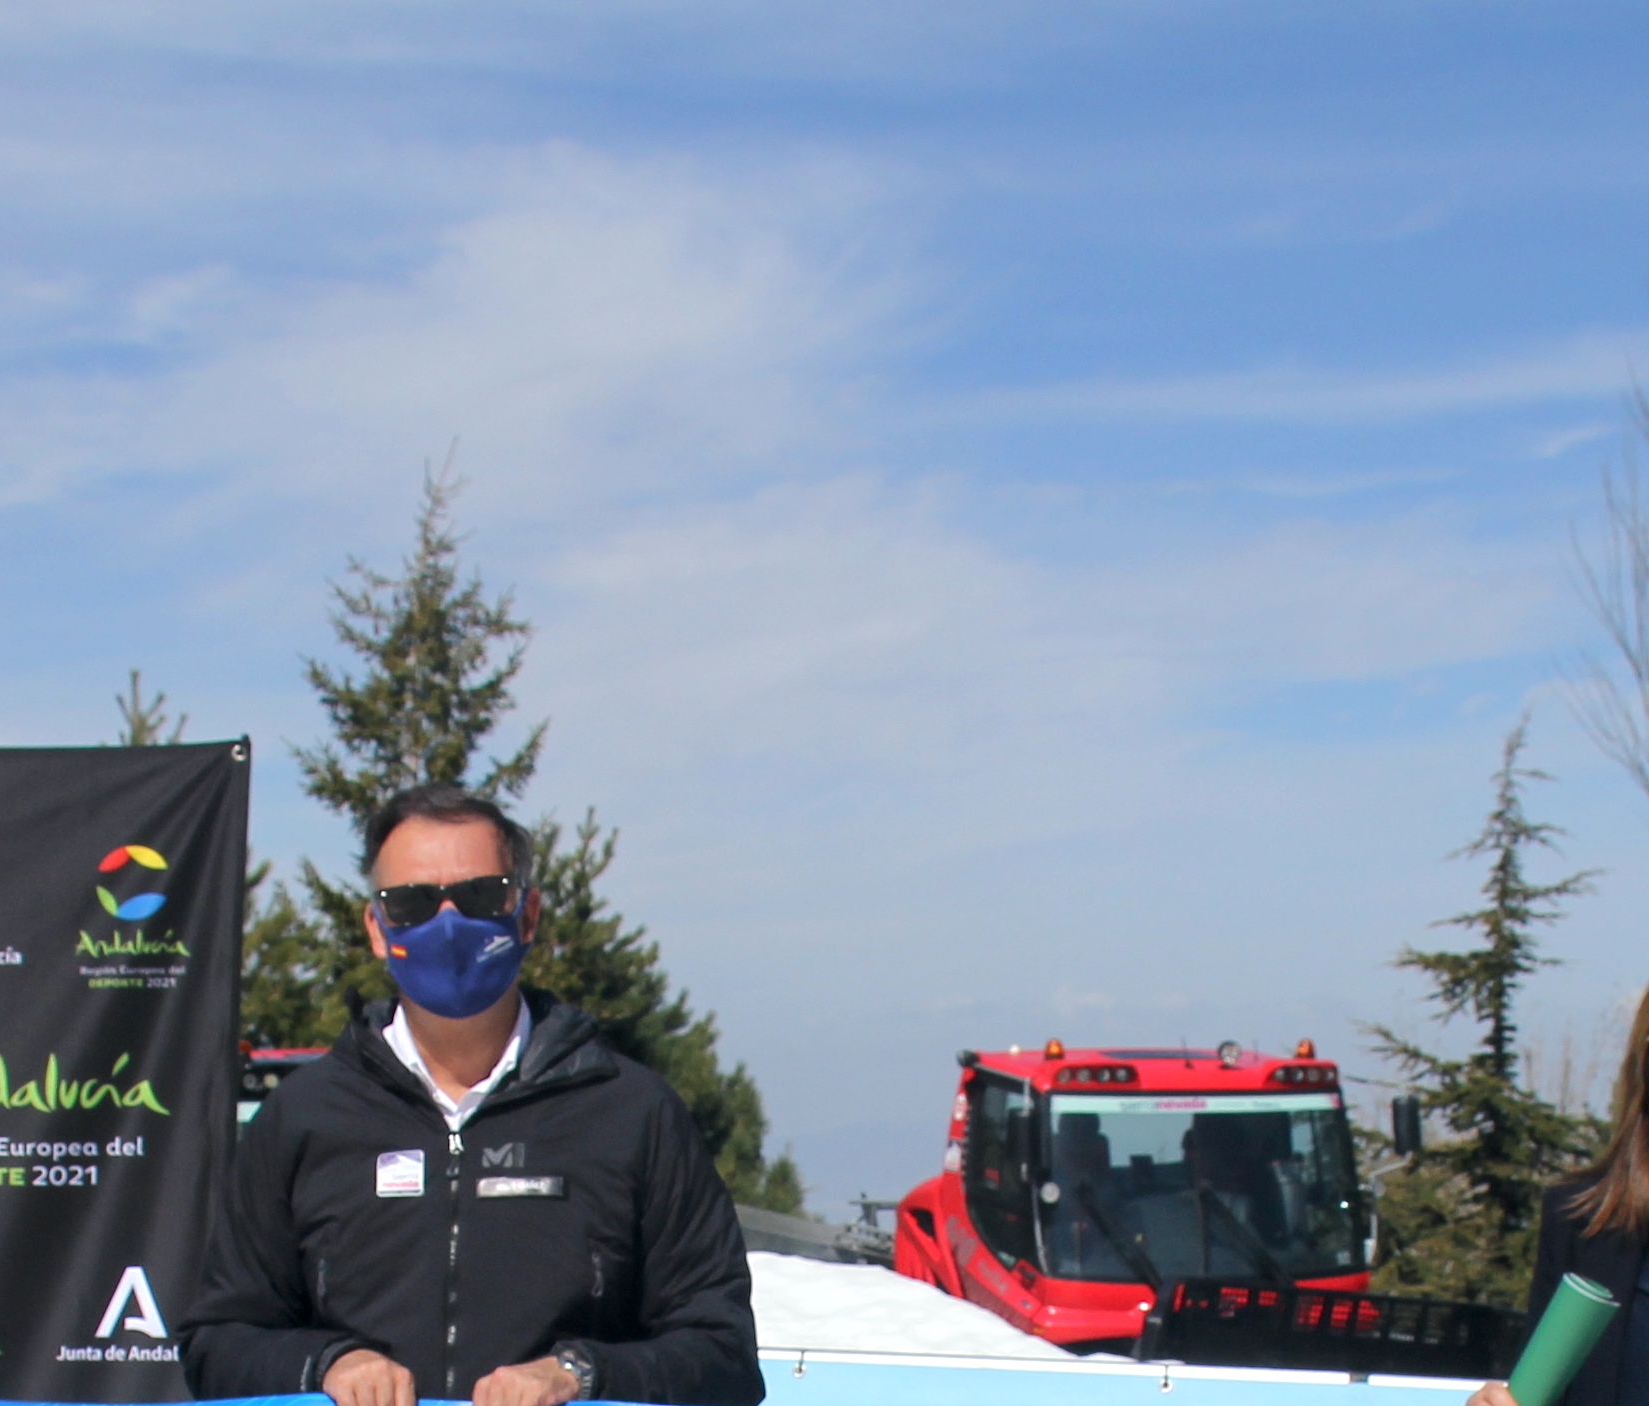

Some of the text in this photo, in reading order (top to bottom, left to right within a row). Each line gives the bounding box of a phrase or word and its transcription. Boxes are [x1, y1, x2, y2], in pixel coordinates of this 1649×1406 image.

[75, 929, 190, 958] Andalucía
[106, 1136, 144, 1156] del
[32, 1165, 98, 1186] 2021
[56, 1345, 179, 1362] Junta de Andal
